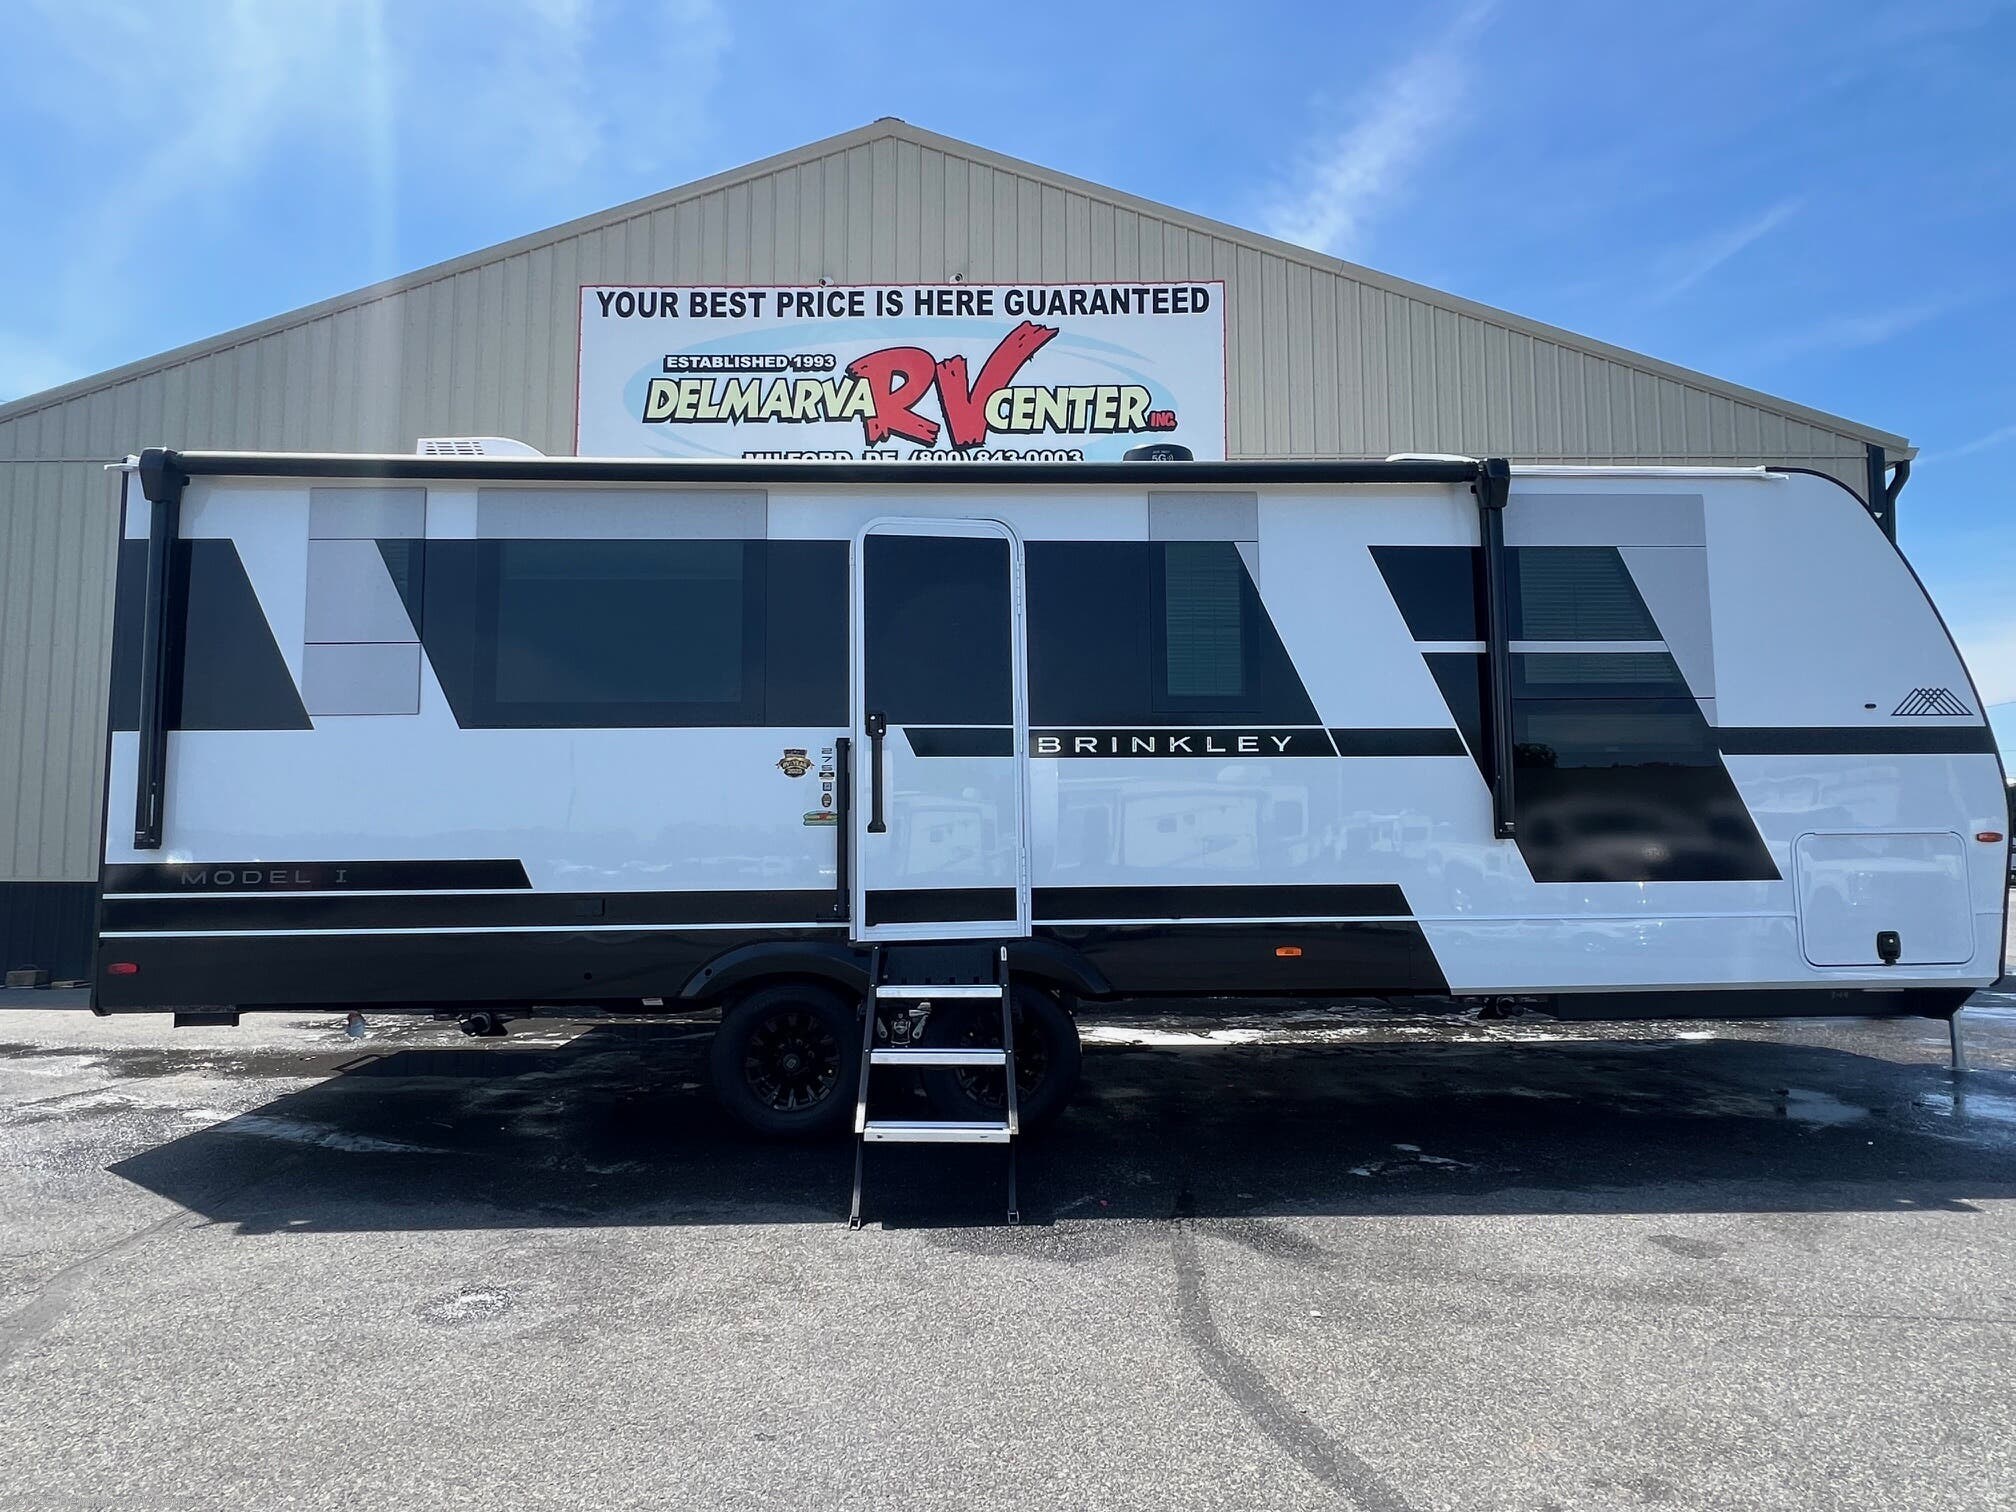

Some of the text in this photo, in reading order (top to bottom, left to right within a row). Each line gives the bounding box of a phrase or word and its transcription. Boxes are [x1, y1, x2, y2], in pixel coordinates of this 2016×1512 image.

[596, 286, 1210, 318] YOUR BEST PRICE IS HERE GUARANTEED
[665, 355, 837, 371] ESTABLISHED 1993
[643, 376, 878, 425] DELMARVA
[845, 319, 1060, 448] RV
[983, 385, 1151, 434] CENTER
[1037, 736, 1293, 753] BRINKLEY
[181, 870, 311, 885] MODEL
